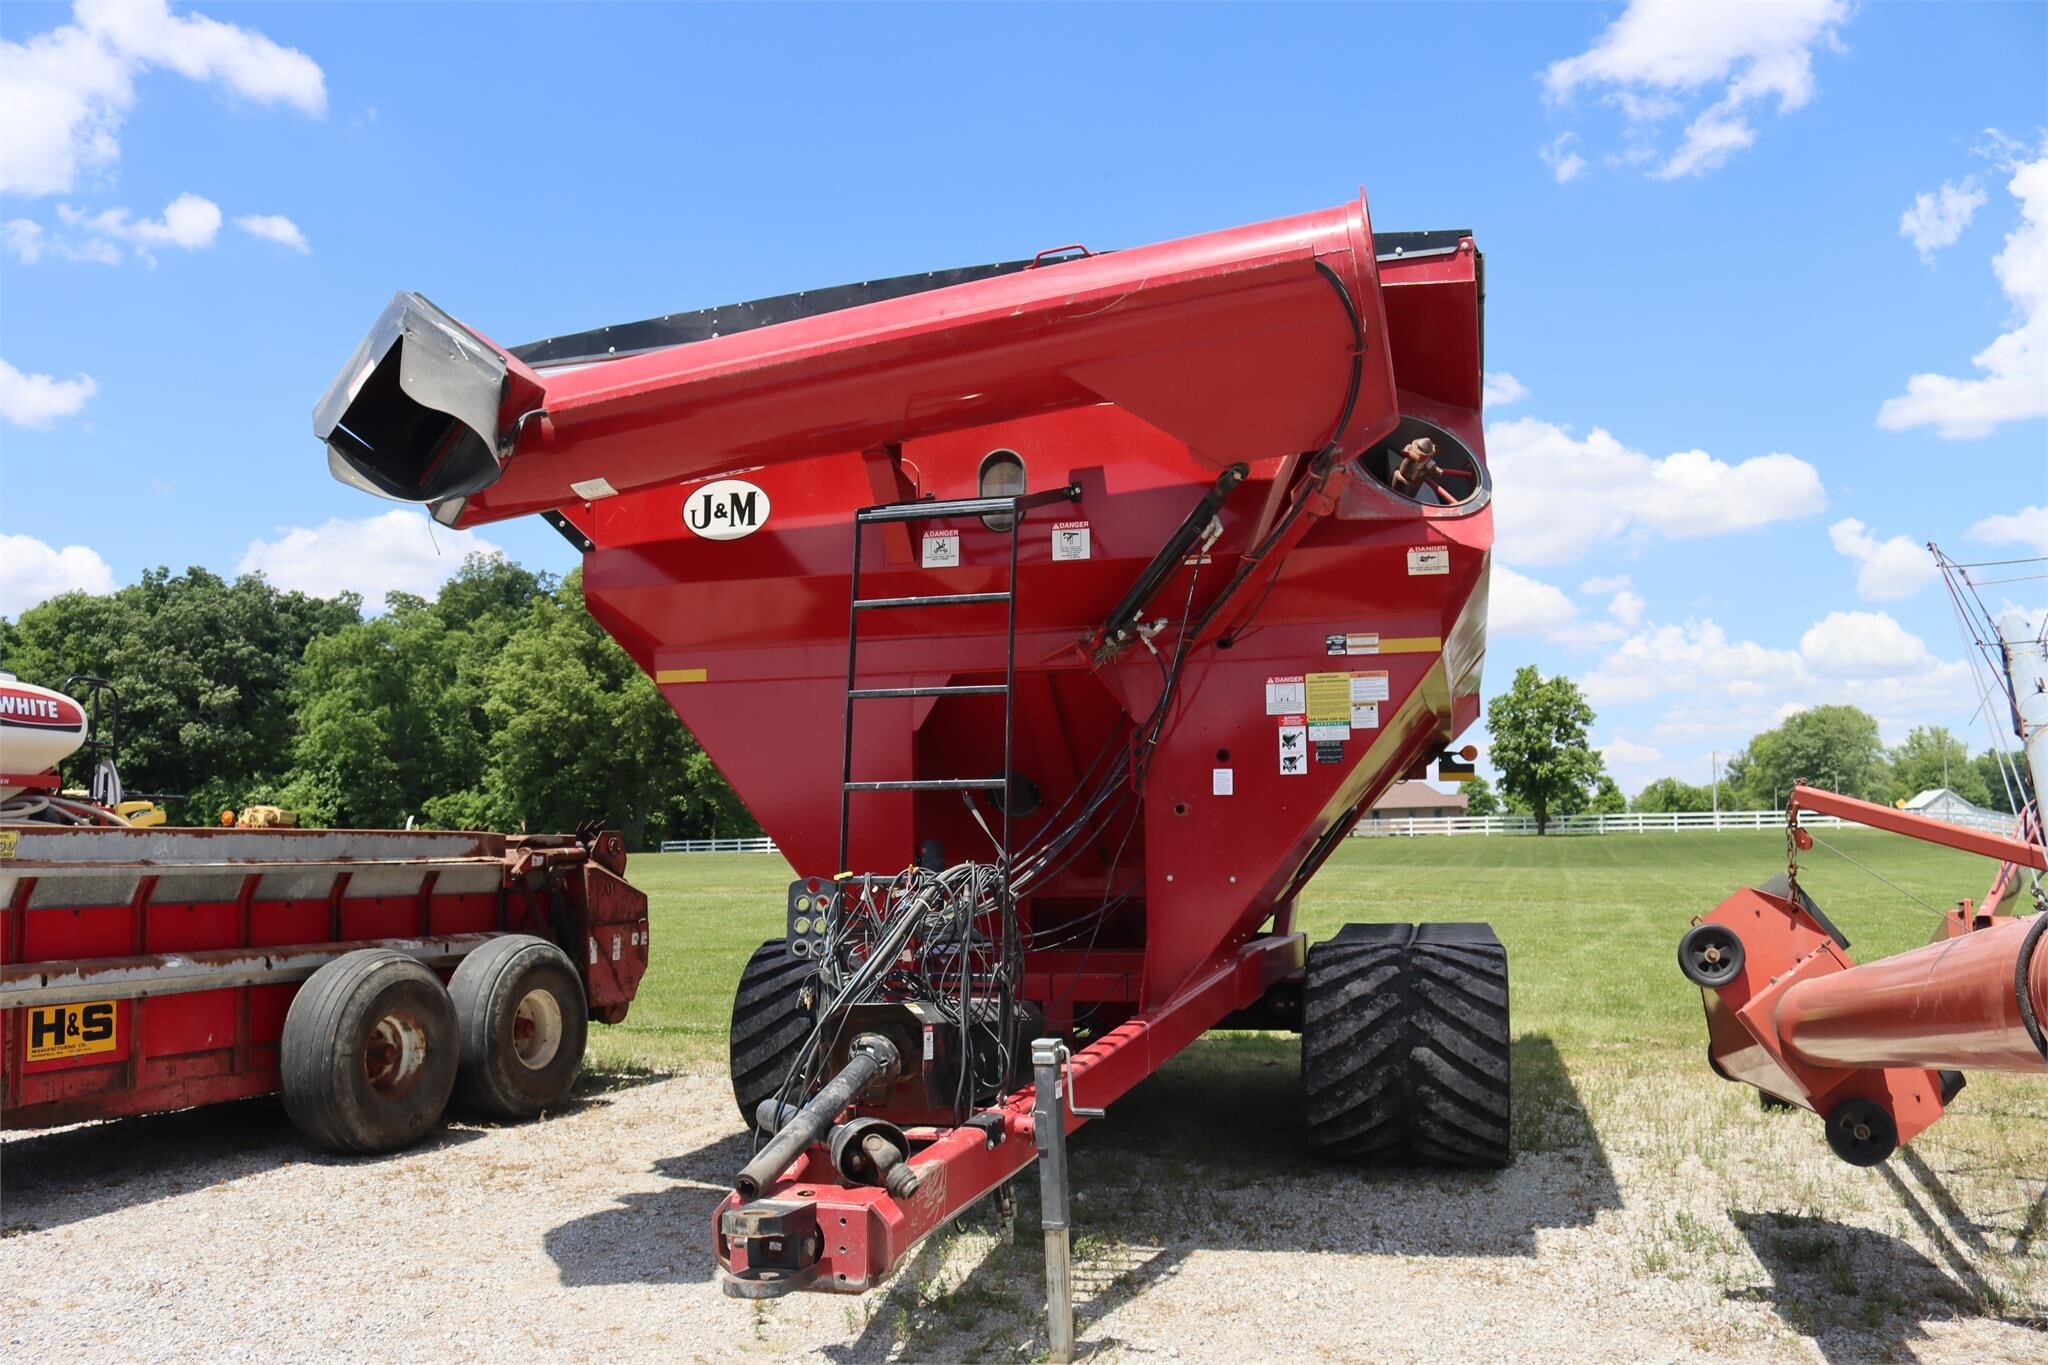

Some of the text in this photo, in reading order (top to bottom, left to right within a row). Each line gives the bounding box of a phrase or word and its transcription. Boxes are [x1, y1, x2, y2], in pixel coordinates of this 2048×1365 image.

[690, 491, 757, 529] J&M
[1059, 521, 1089, 529] DANGER
[929, 529, 959, 538] DANGER
[1415, 545, 1448, 553] DANGER
[0, 696, 59, 718] WHITE
[32, 1004, 113, 1049] H&S
[31, 1043, 77, 1054] MANUFACTURING
